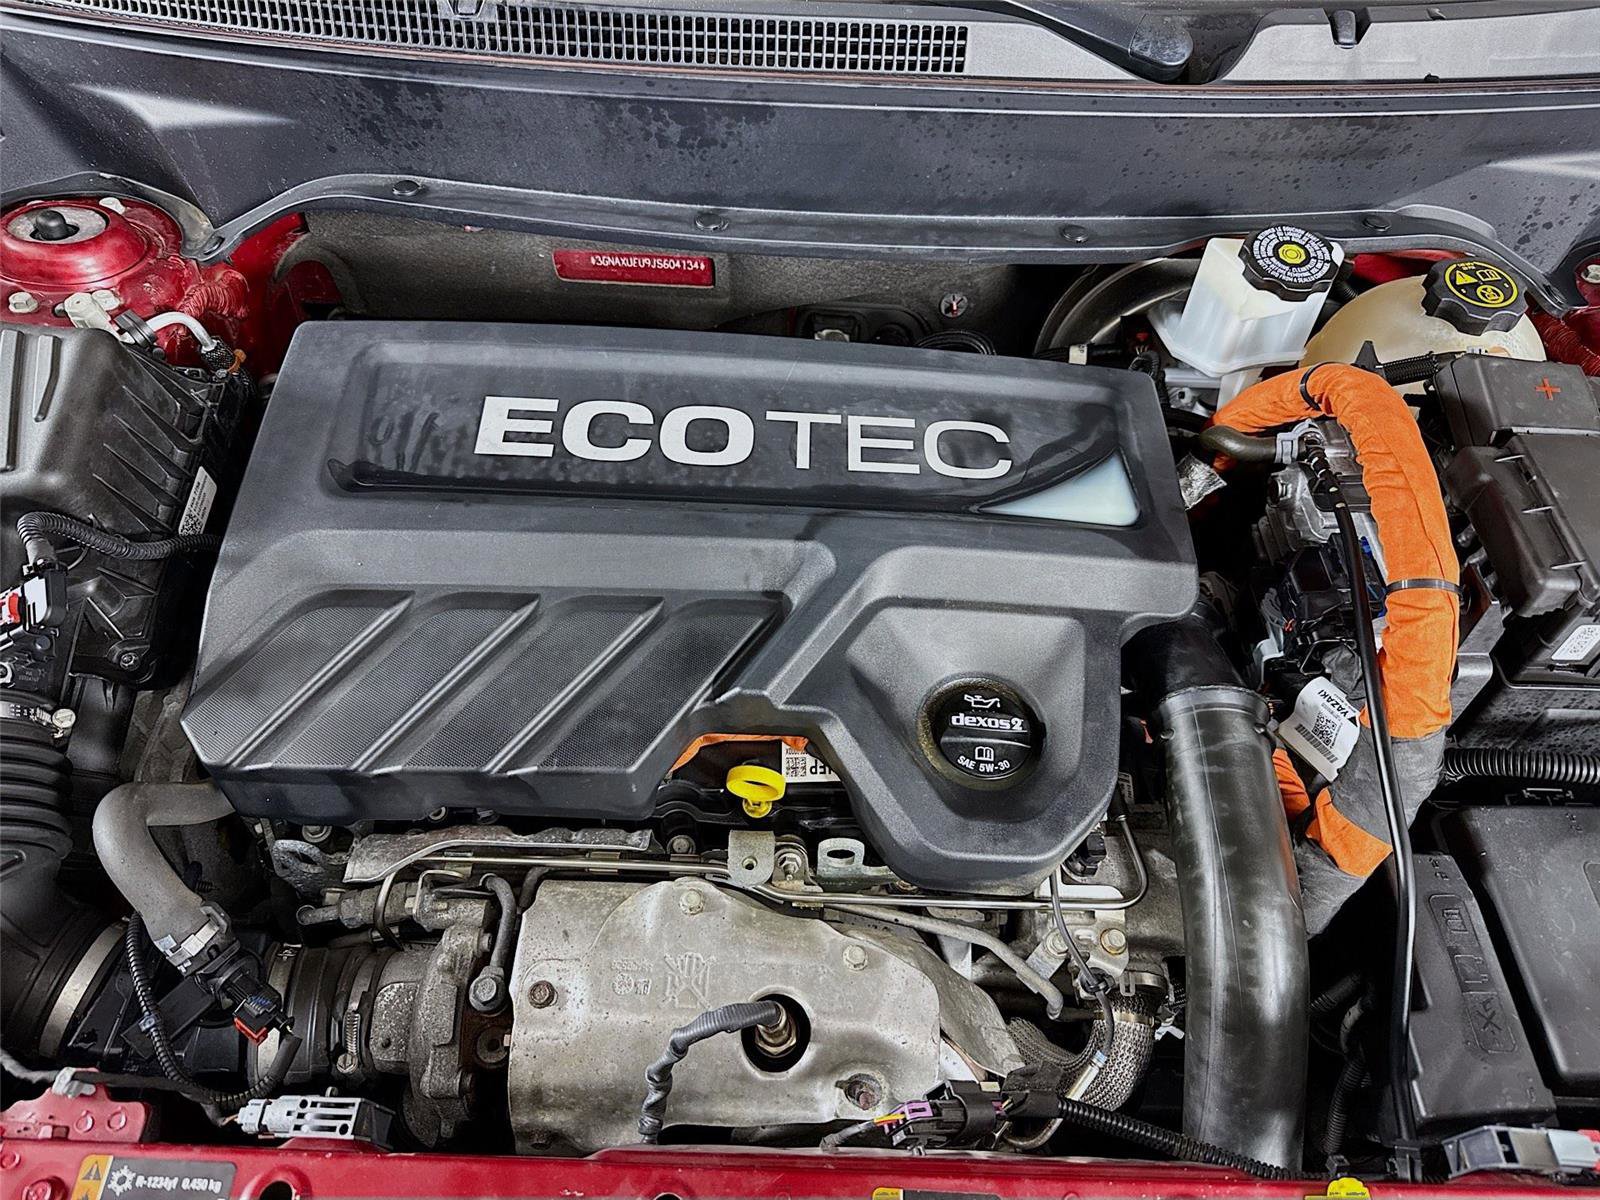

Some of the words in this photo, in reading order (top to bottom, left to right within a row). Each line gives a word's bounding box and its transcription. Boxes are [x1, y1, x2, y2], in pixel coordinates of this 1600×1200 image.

[596, 255, 700, 271] 3GNAXUEU9JS604134
[473, 396, 1013, 479] ECOTEC
[1318, 689, 1349, 717] YAZAKI
[951, 712, 1024, 731] dexos2
[957, 755, 976, 770] SAE
[978, 759, 1011, 773] 5W-30
[181, 1177, 207, 1191] 0.450
[208, 1179, 222, 1194] kg
